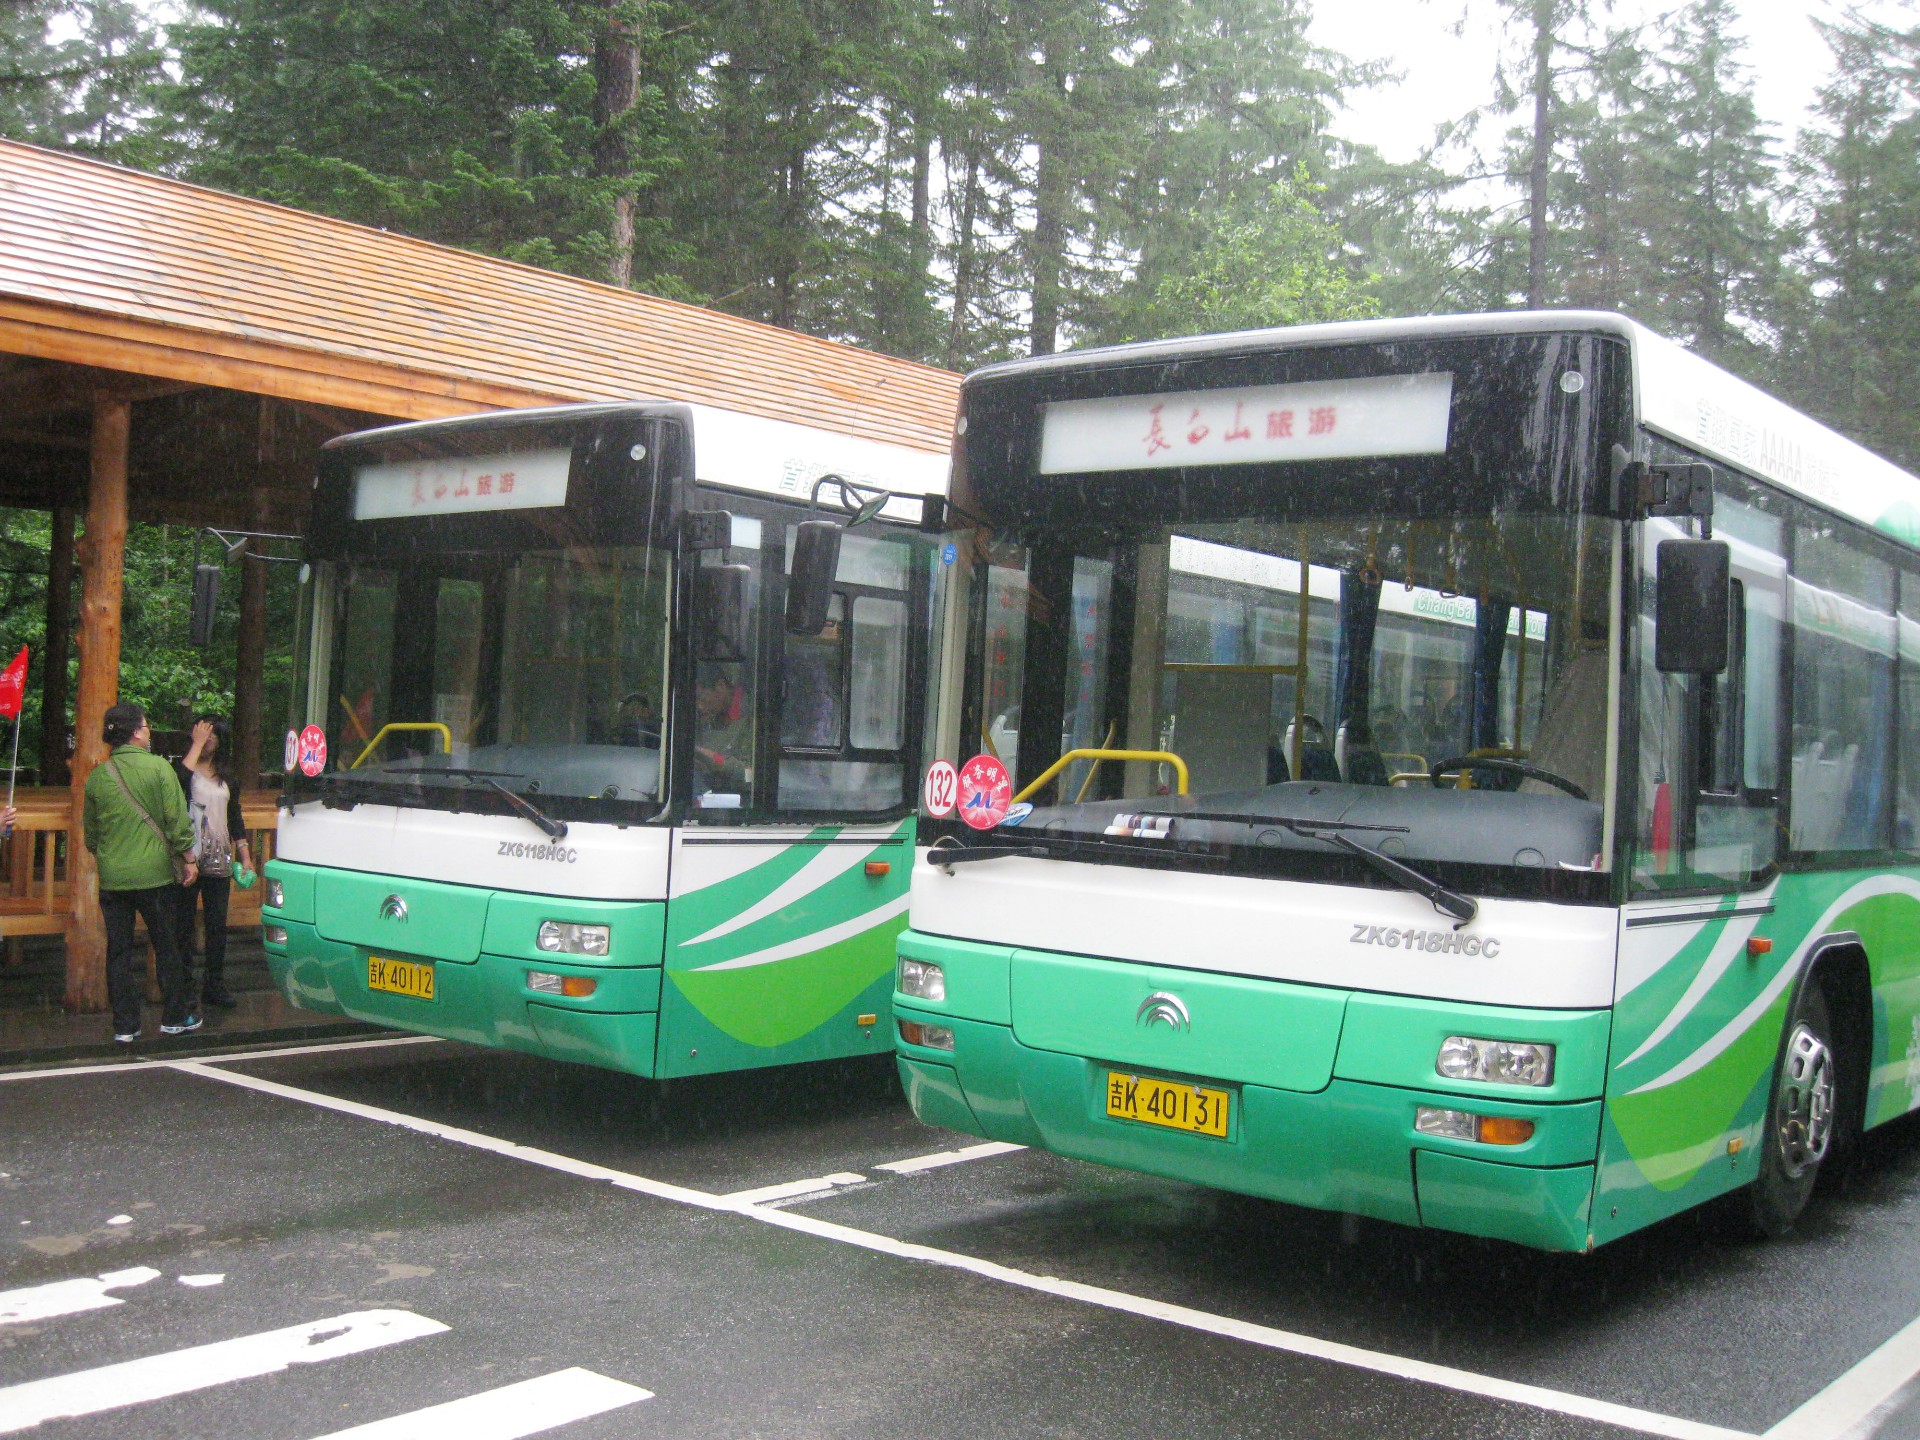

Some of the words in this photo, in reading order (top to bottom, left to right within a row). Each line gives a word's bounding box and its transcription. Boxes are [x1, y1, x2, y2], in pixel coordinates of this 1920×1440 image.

[1417, 591, 1455, 621] Chang
[928, 769, 953, 808] 132
[497, 841, 578, 863] ZK6118HGC
[1350, 923, 1501, 959] ZK6118HGC
